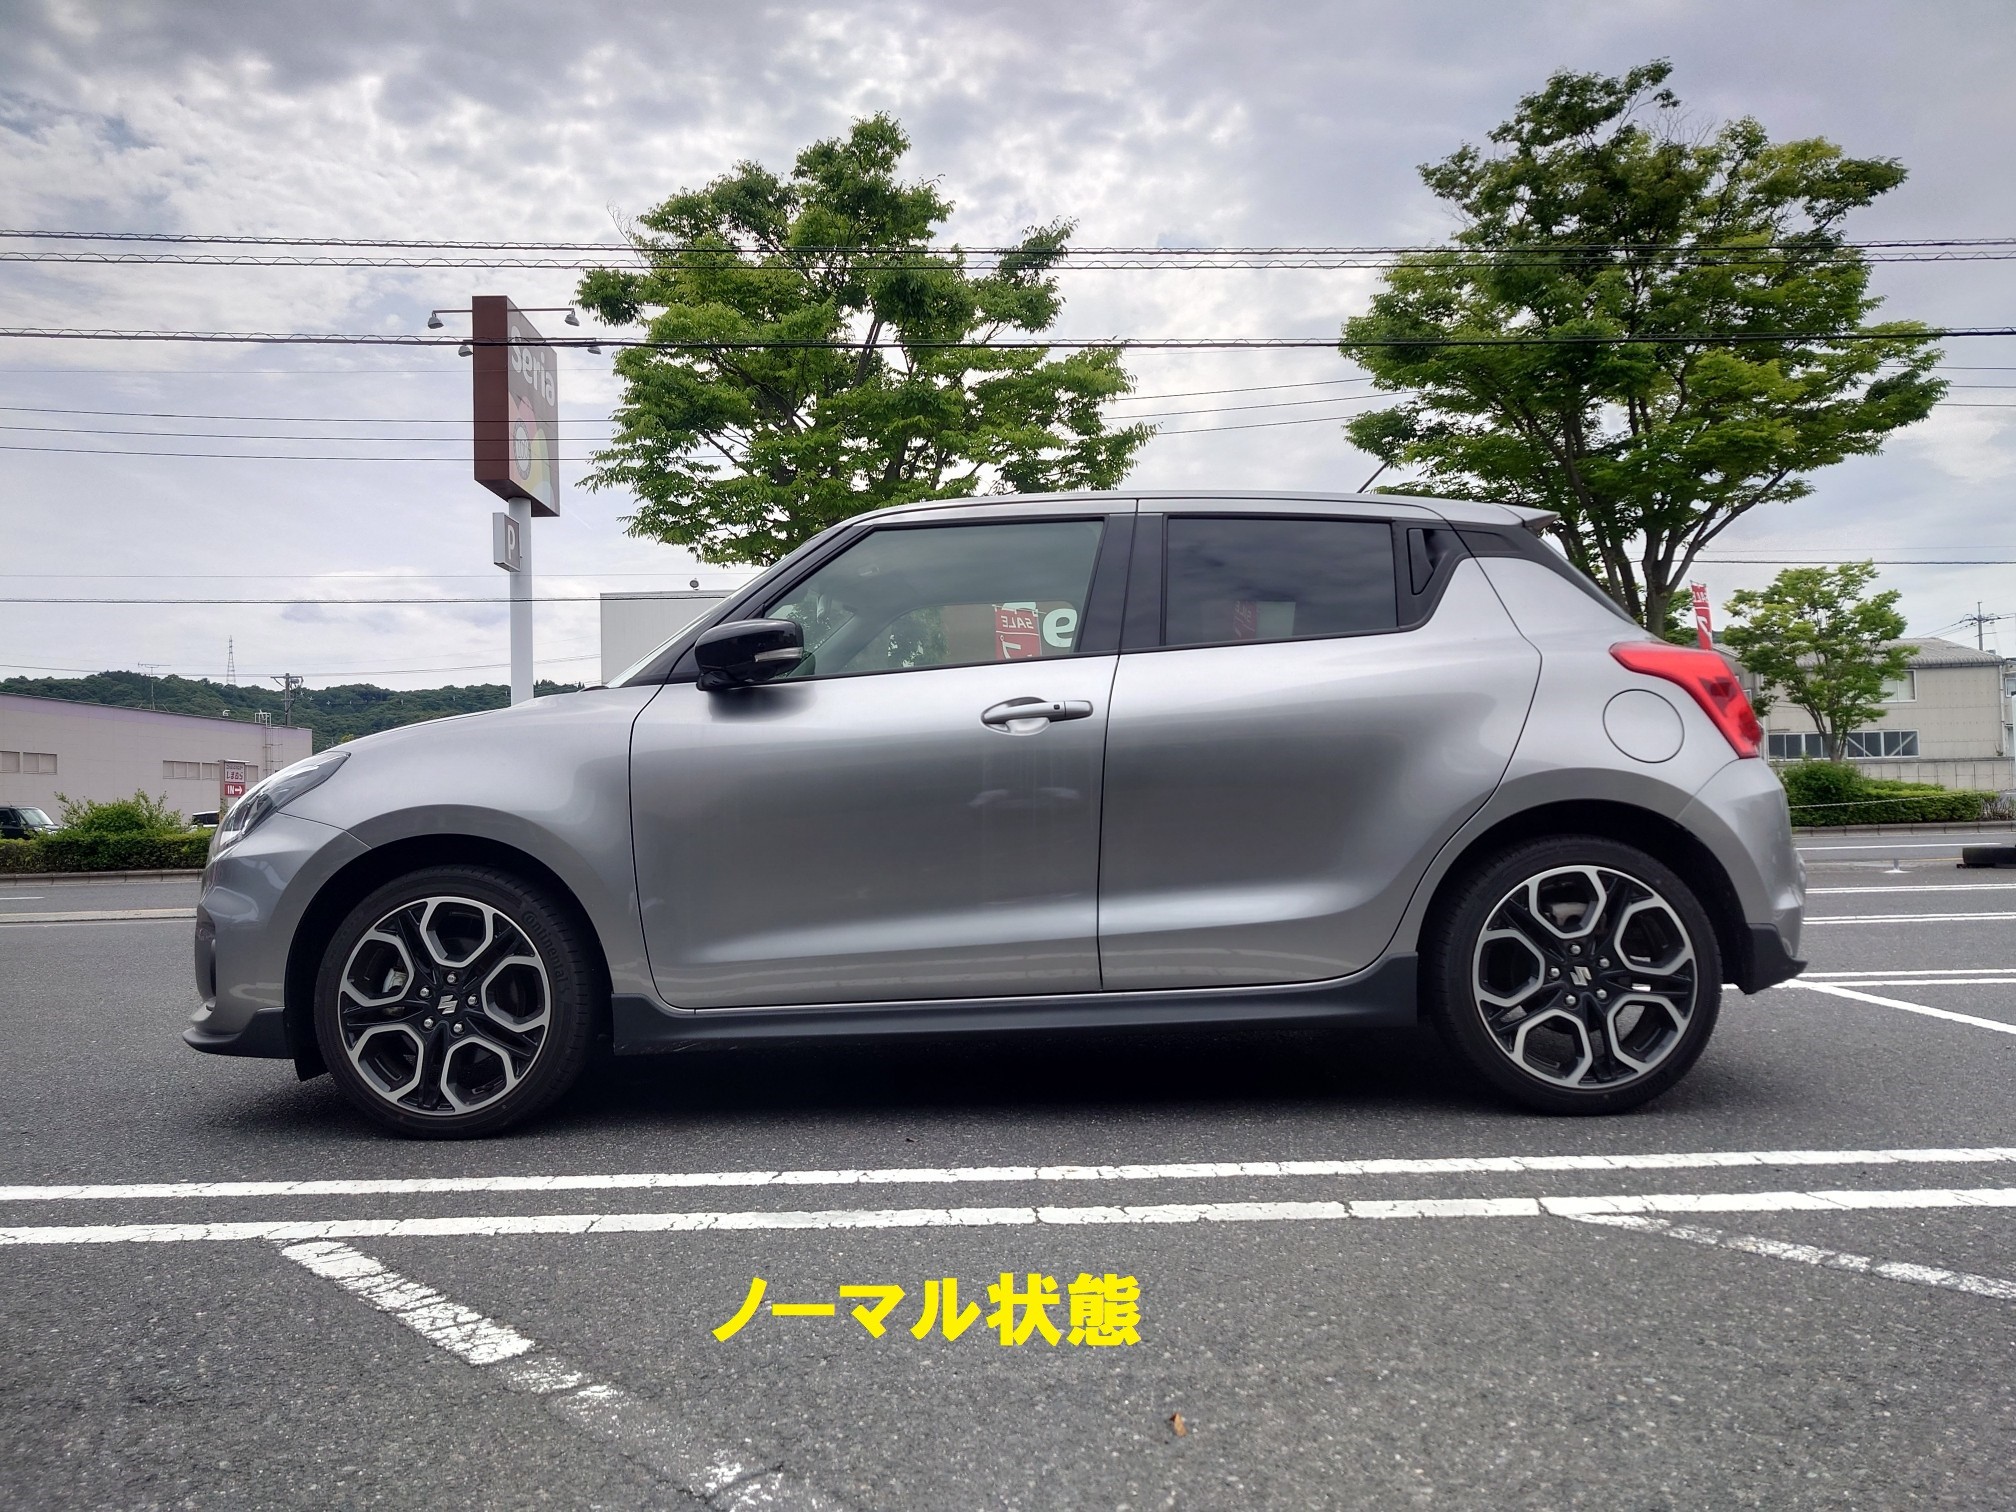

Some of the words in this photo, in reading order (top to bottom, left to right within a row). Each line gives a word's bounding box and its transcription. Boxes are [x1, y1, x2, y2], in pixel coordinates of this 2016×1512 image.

[511, 325, 555, 406] Seria
[507, 524, 516, 560] P
[227, 785, 235, 795] IN
[523, 911, 568, 982] Continental
